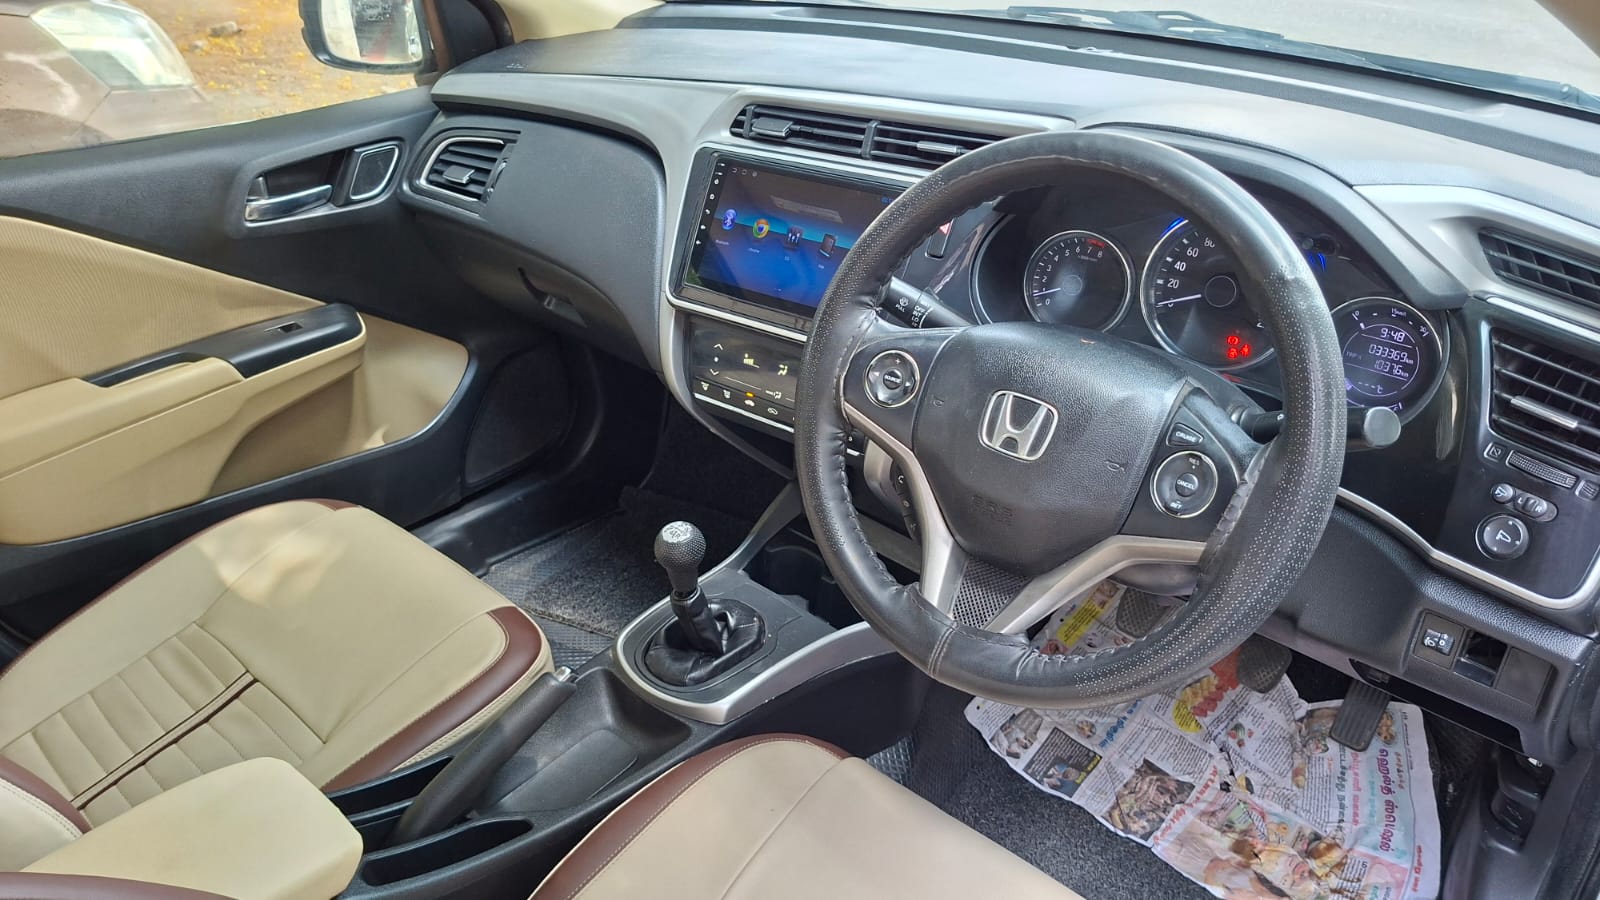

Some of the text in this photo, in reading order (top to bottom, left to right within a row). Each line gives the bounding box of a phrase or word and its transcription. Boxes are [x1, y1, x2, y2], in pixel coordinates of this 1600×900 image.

[1186, 247, 1199, 258] 60
[1173, 261, 1186, 272] 40
[1167, 278, 1180, 289] 20
[1380, 327, 1406, 342] 9:48
[1368, 343, 1408, 363] 033369
[1175, 431, 1197, 443] CRUISE
[1177, 479, 1195, 490] CANCEL
